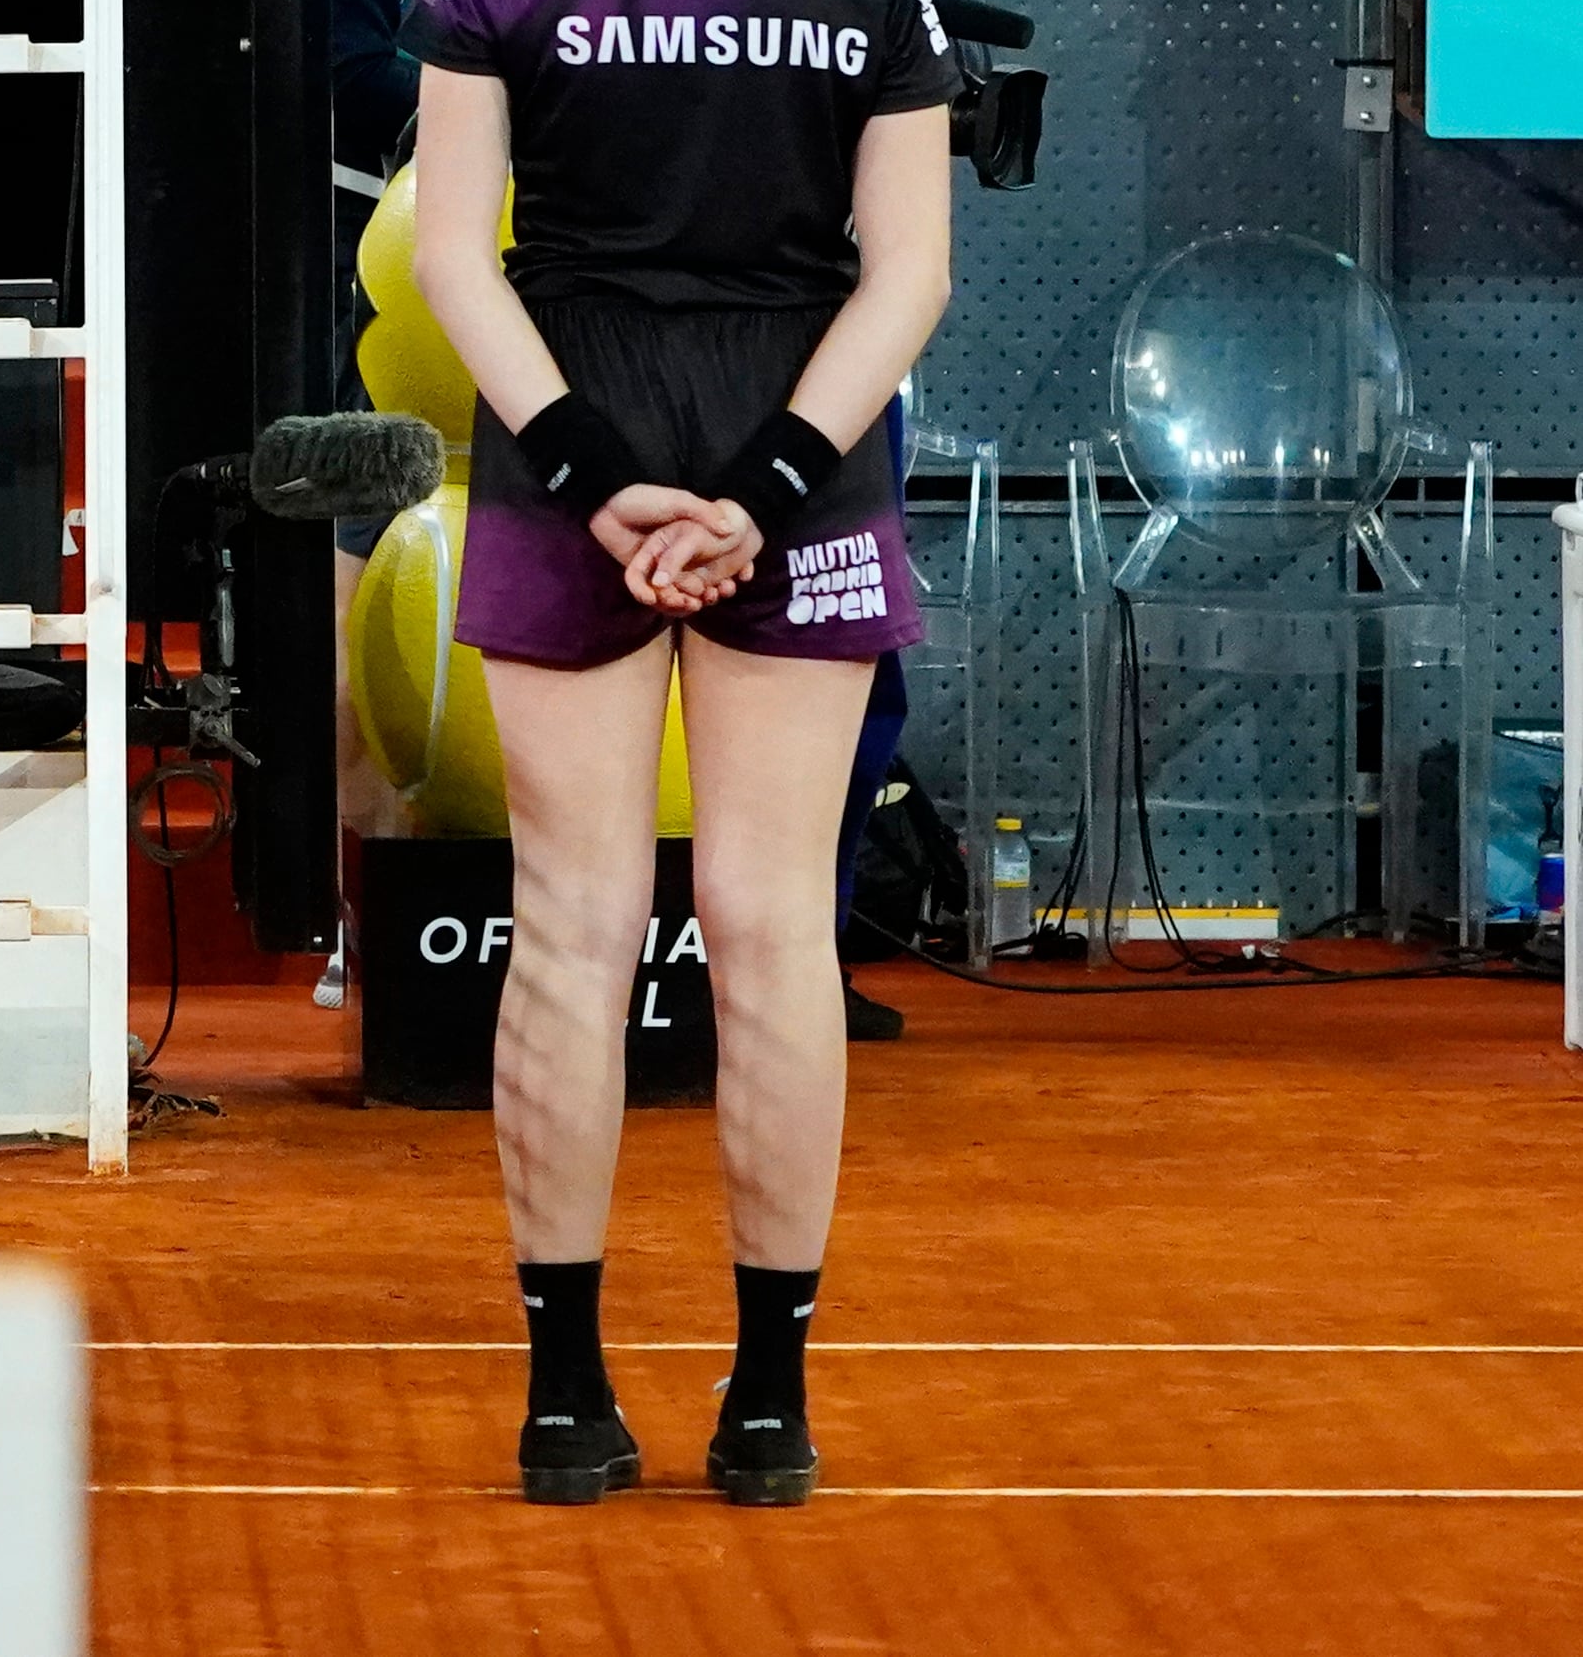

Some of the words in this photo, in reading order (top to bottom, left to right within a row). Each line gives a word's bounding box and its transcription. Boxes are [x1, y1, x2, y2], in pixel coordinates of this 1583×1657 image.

[556, 15, 868, 76] SAMSUNG
[786, 531, 880, 578] MUTUA
[792, 561, 883, 599] MADRID
[786, 586, 888, 625] OPEN
